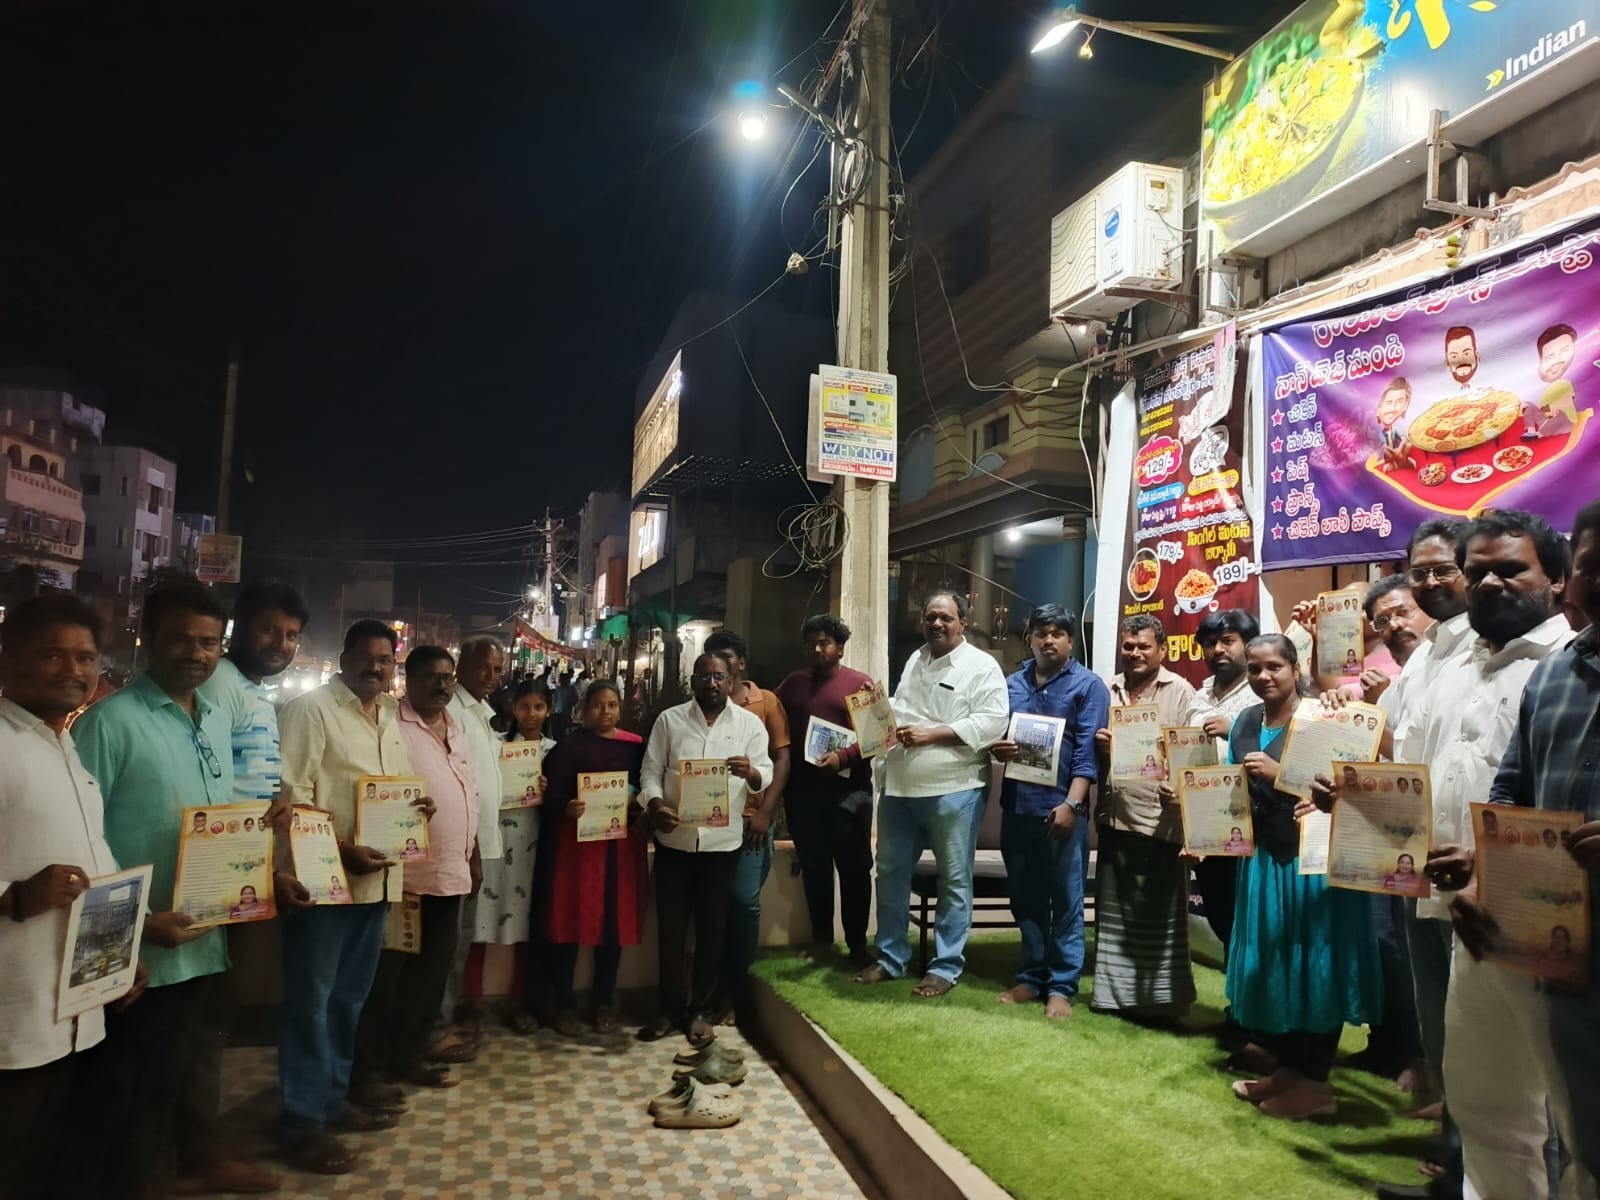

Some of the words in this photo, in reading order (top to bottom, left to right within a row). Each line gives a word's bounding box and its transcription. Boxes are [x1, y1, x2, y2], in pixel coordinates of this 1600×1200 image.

[1505, 19, 1587, 81] Indian
[1158, 543, 1183, 562] 179/-
[1215, 558, 1254, 584] 189/-
